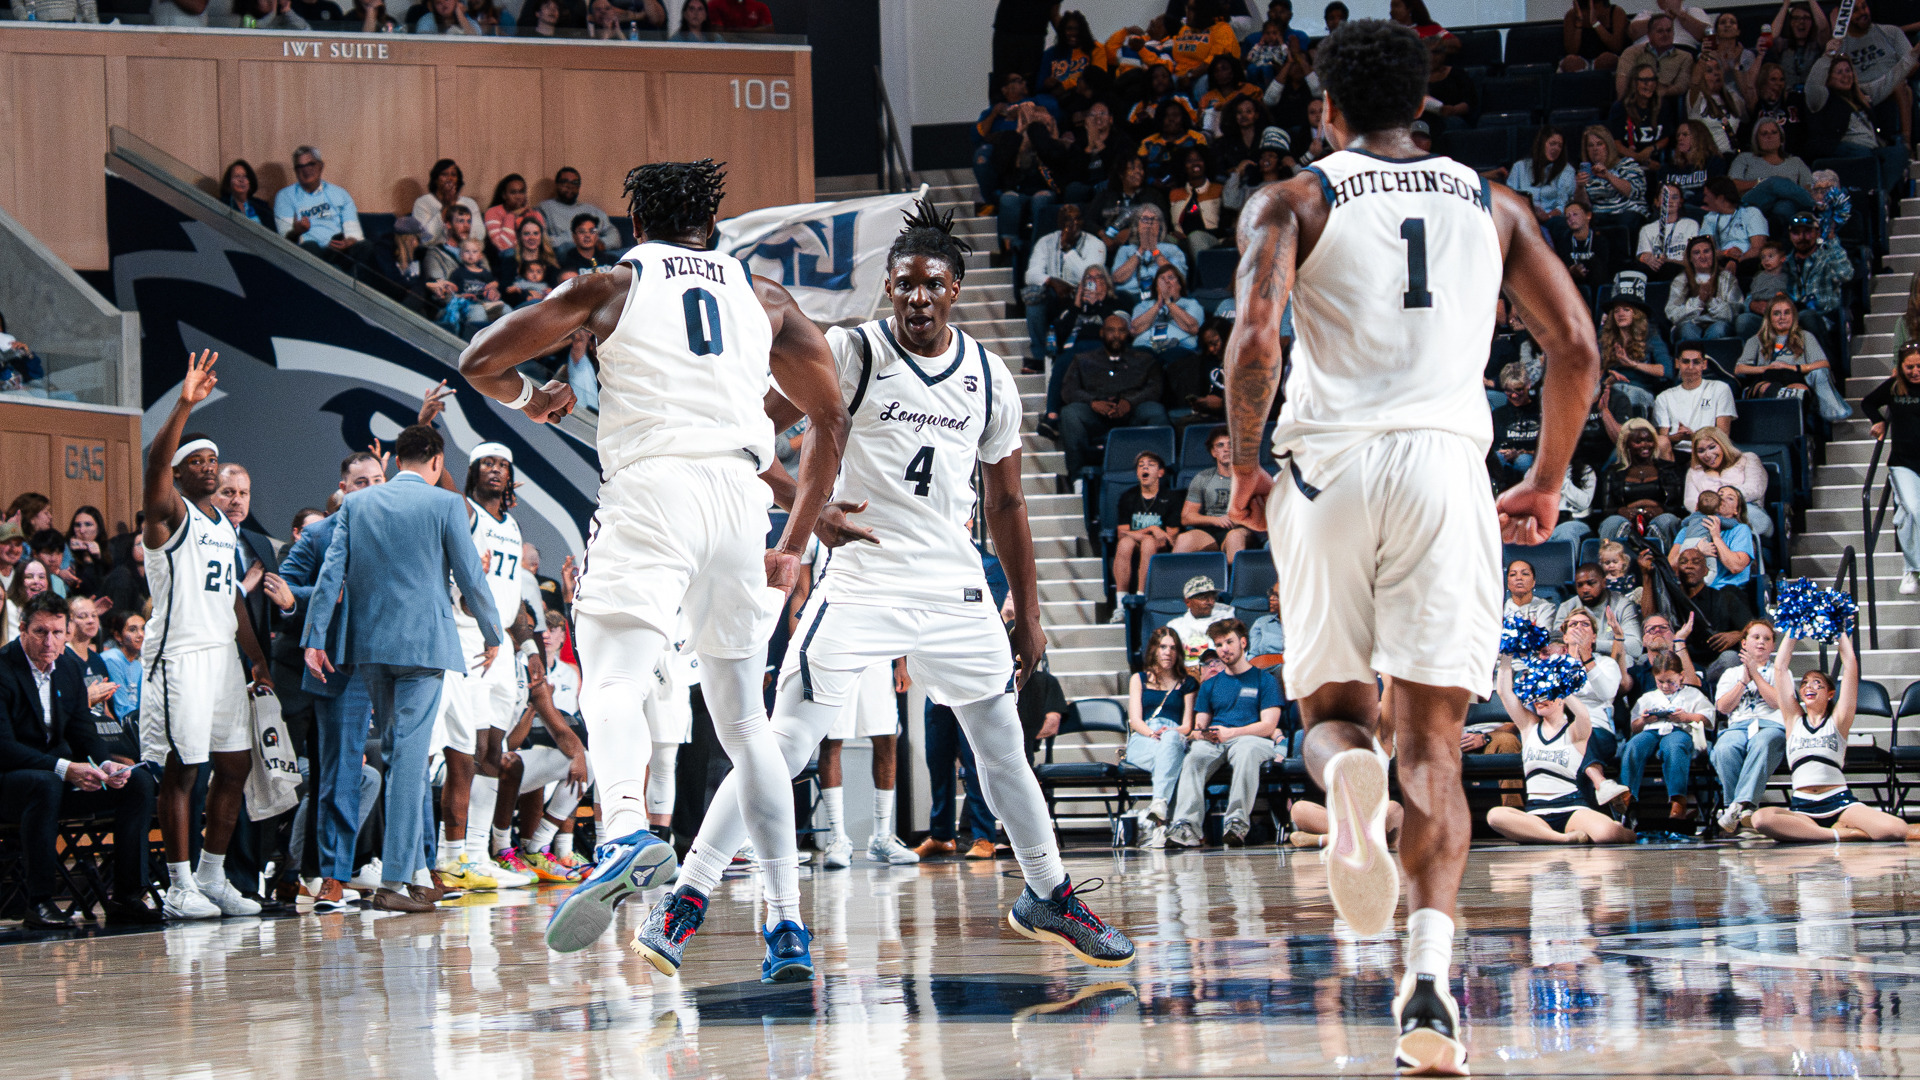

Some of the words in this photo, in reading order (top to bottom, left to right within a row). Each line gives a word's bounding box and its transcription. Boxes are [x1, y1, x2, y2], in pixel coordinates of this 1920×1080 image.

[283, 41, 323, 58] IWT
[330, 43, 389, 60] SUITE
[730, 79, 790, 110] 106
[1332, 169, 1484, 206] HUTCHINSON
[662, 256, 727, 286] NZIEMI
[1400, 217, 1433, 309] 1
[682, 287, 724, 357] 0
[879, 401, 971, 433] Longwood
[904, 445, 936, 498] 4
[204, 559, 233, 596] 24
[493, 549, 519, 581] 77
